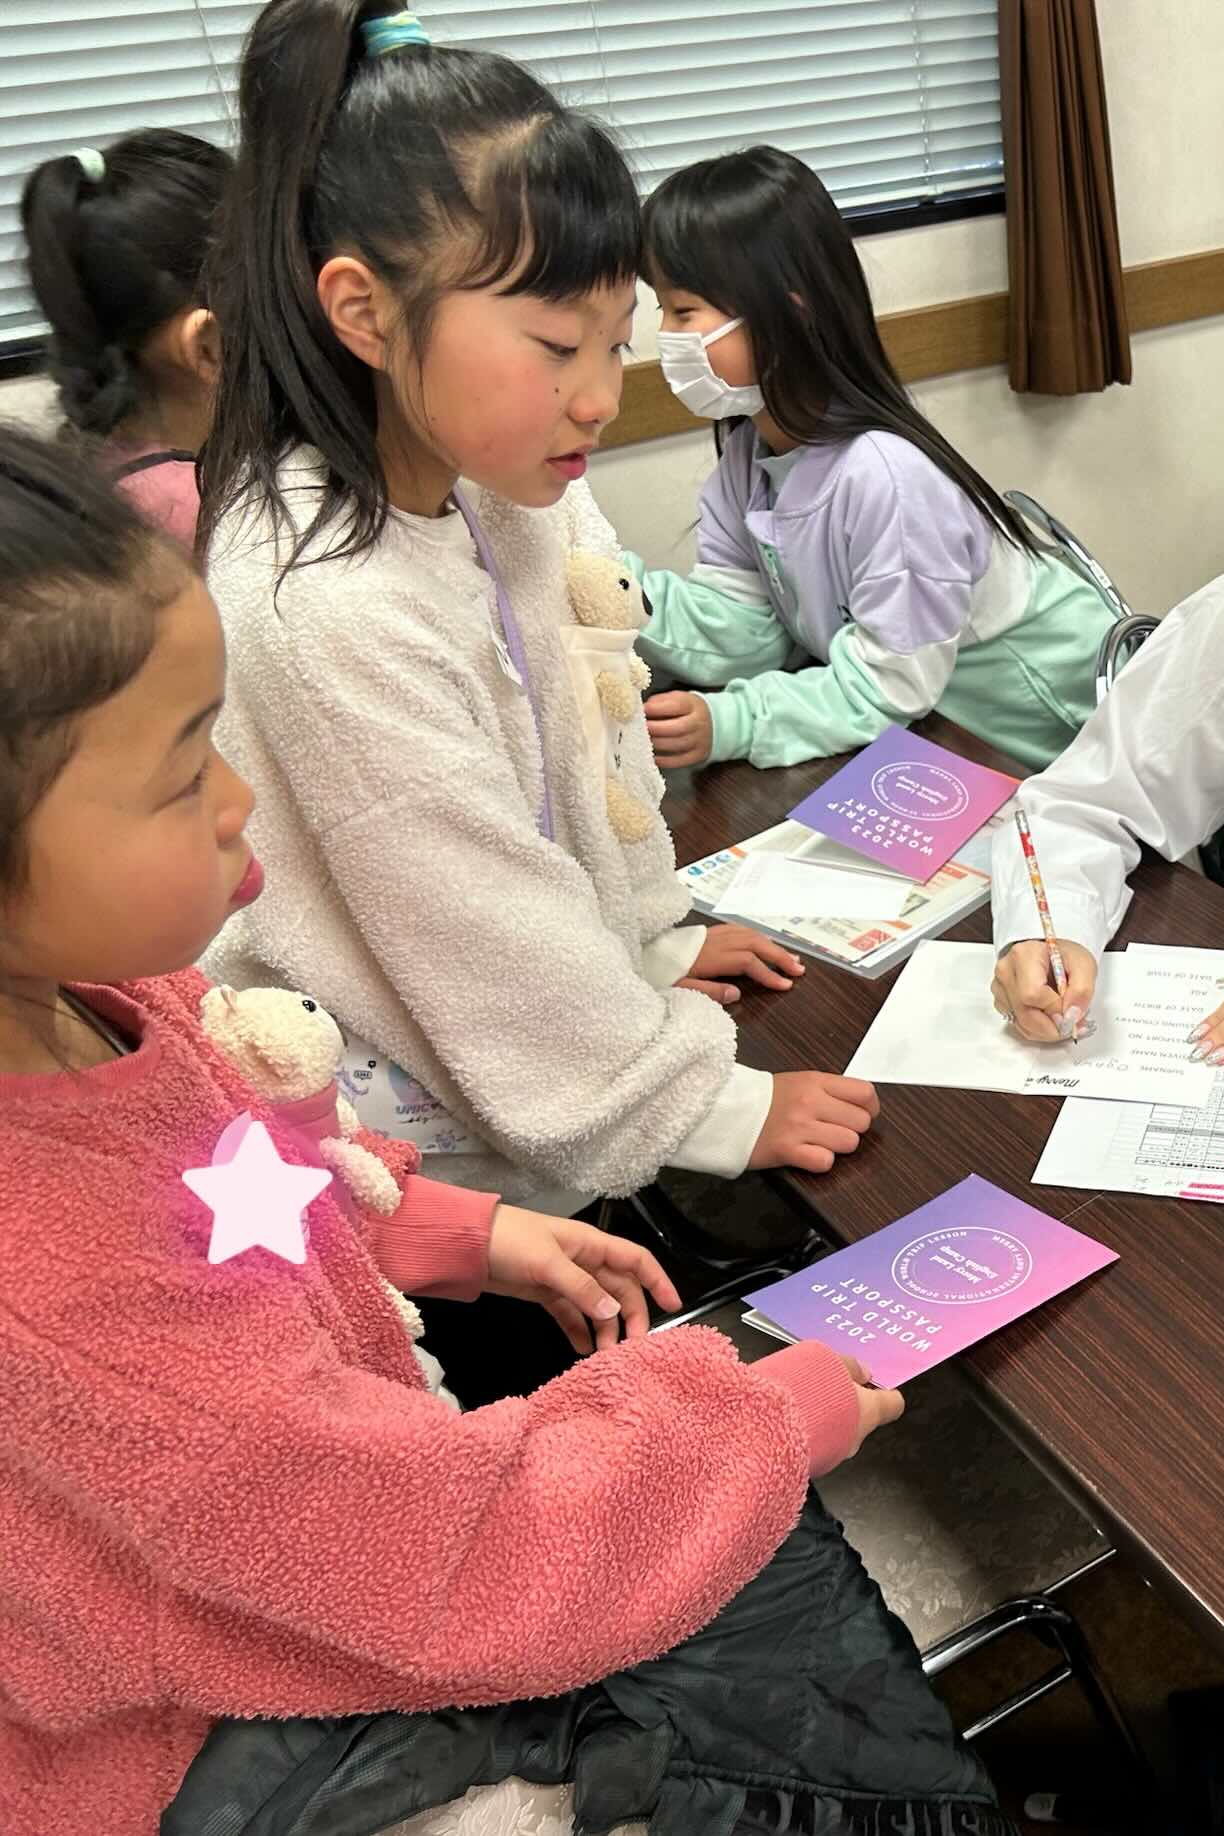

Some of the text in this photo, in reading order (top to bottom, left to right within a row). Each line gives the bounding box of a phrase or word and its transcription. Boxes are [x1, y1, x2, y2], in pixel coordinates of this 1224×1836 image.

[827, 803, 933, 856] WORLD TRIP
[844, 798, 934, 843] PASSPORT
[851, 824, 893, 848] 2023
[810, 1283, 933, 1353] WORLD TRIP
[825, 1313, 877, 1344] 2023
[840, 1277, 943, 1334] PASSPORT
